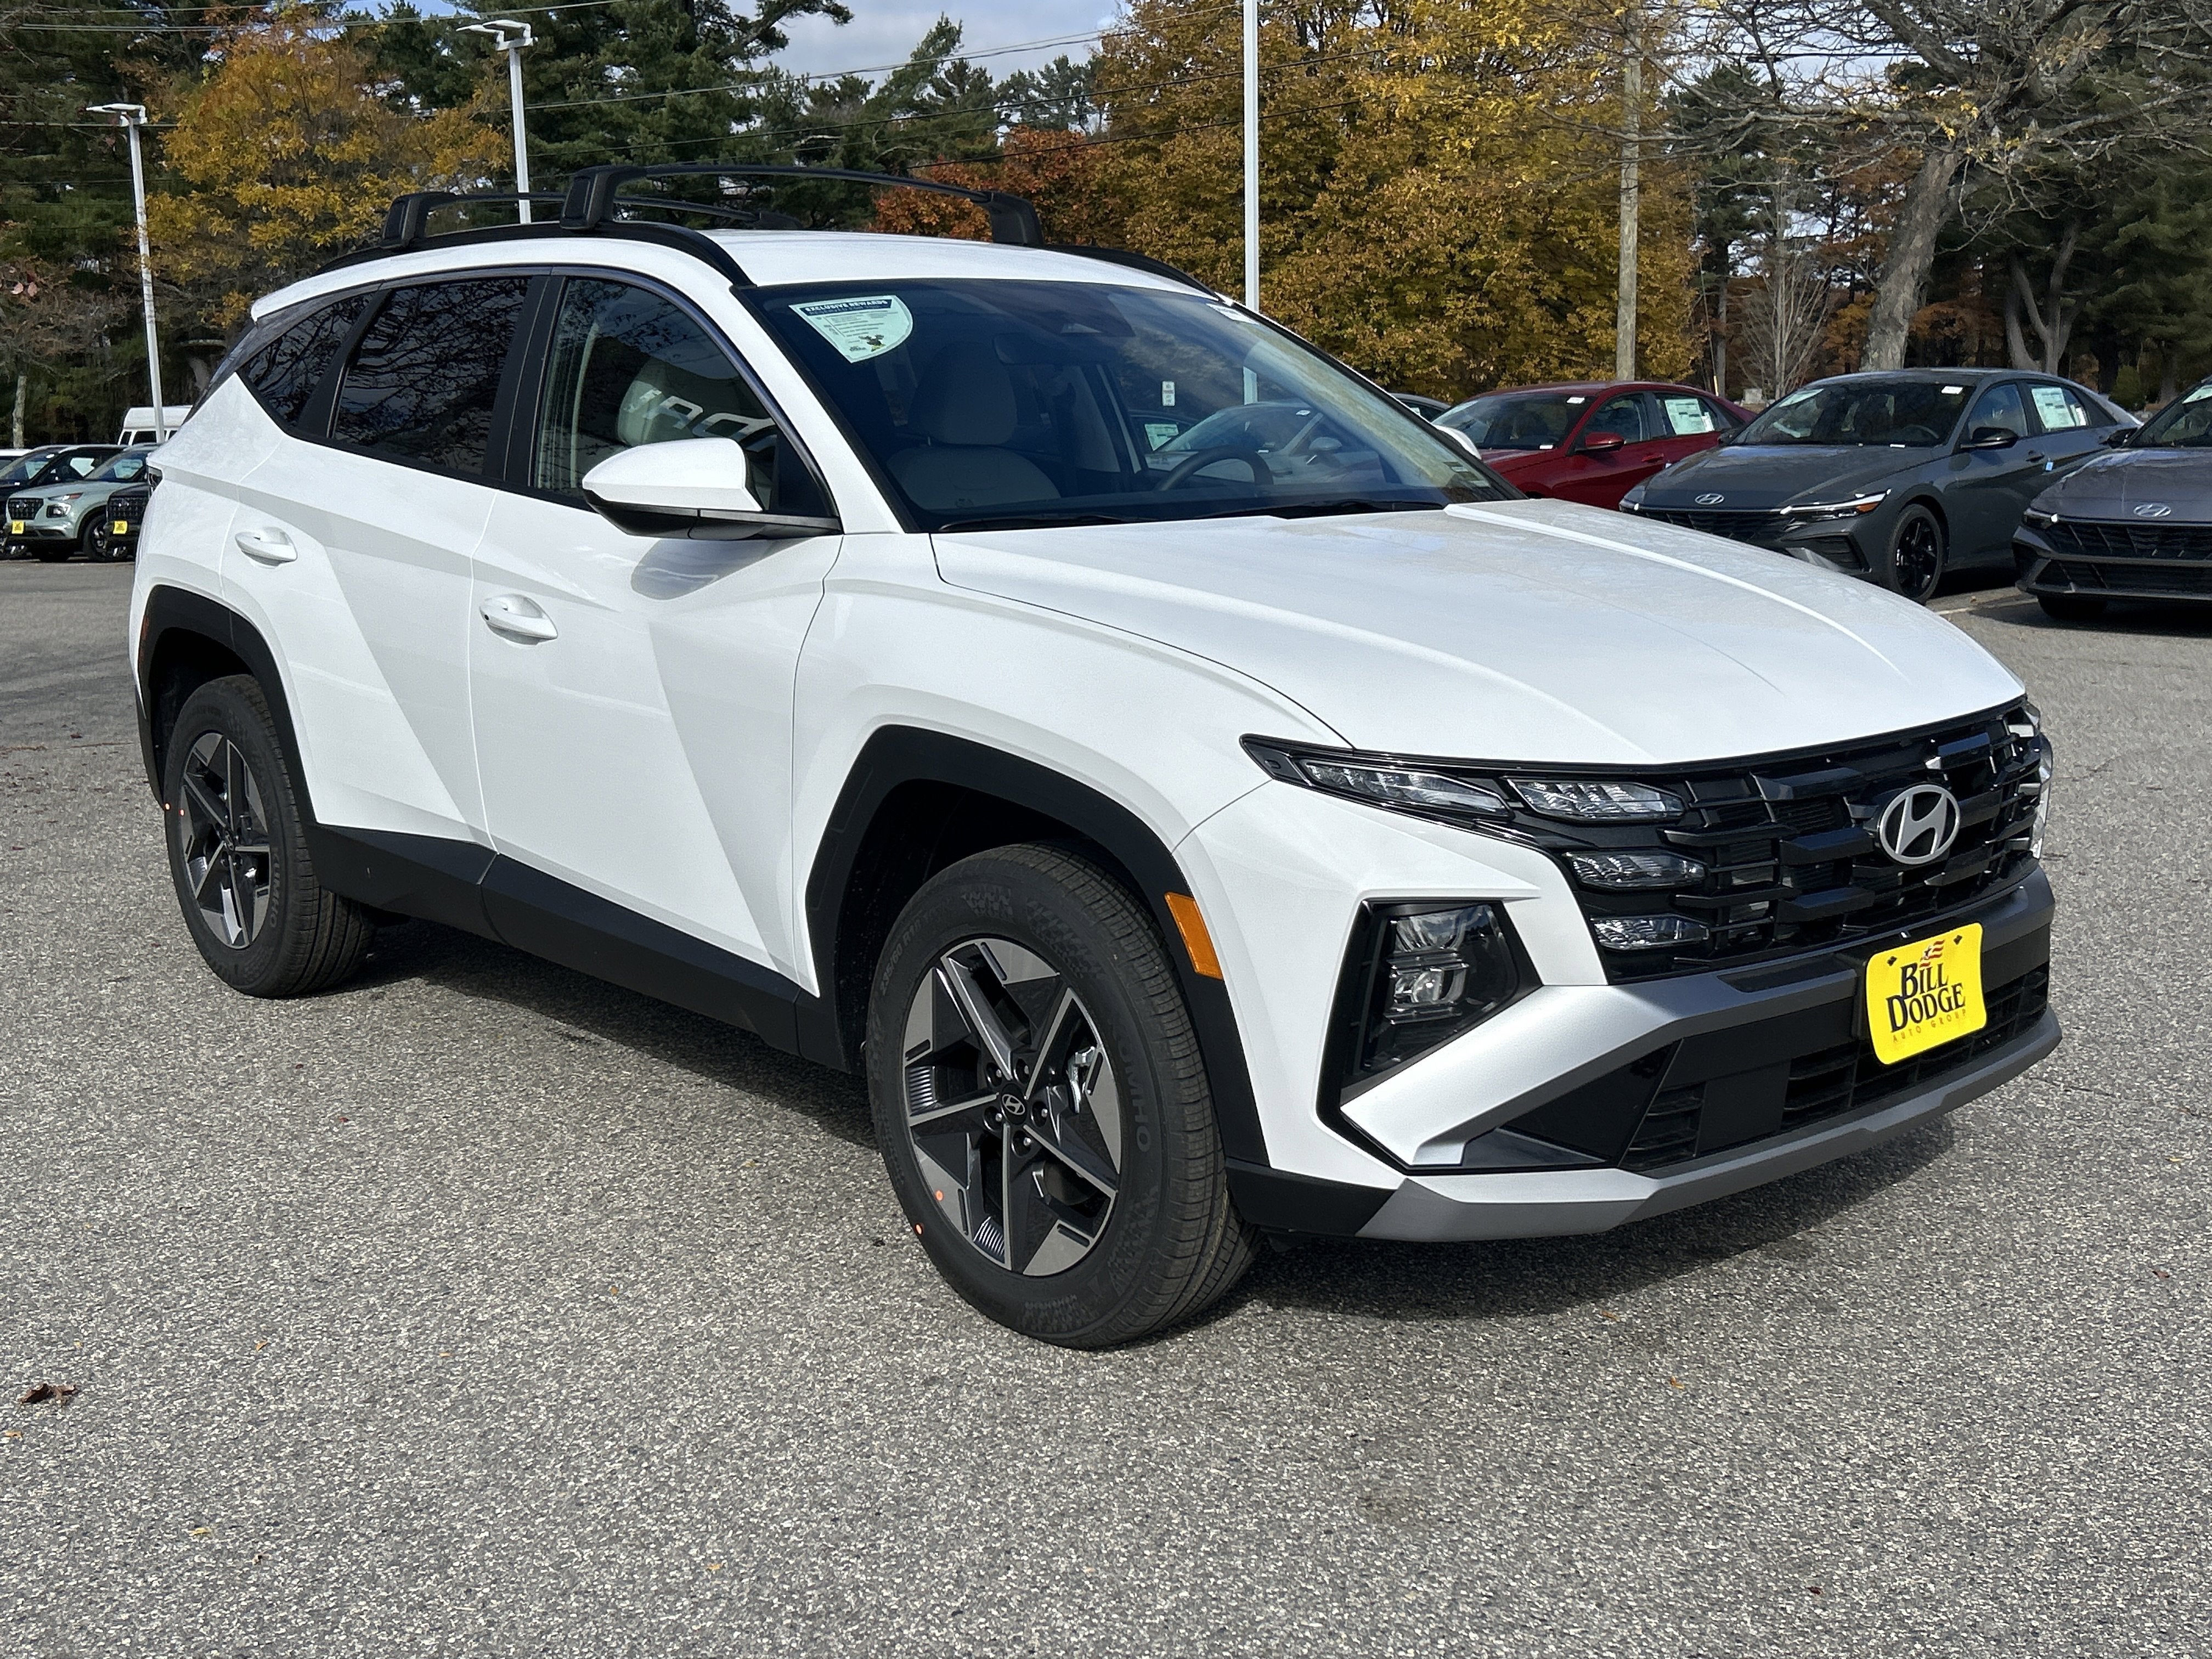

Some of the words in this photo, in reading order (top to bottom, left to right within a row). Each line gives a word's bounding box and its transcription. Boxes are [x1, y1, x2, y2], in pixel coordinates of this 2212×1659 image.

[805, 303, 849, 312] EXCLUSIVE
[1900, 962, 1949, 1000] BILL
[1886, 983, 1966, 1033] DODGE
[1893, 1025, 1921, 1042] AUTO
[1931, 1008, 1966, 1028] GROUP
